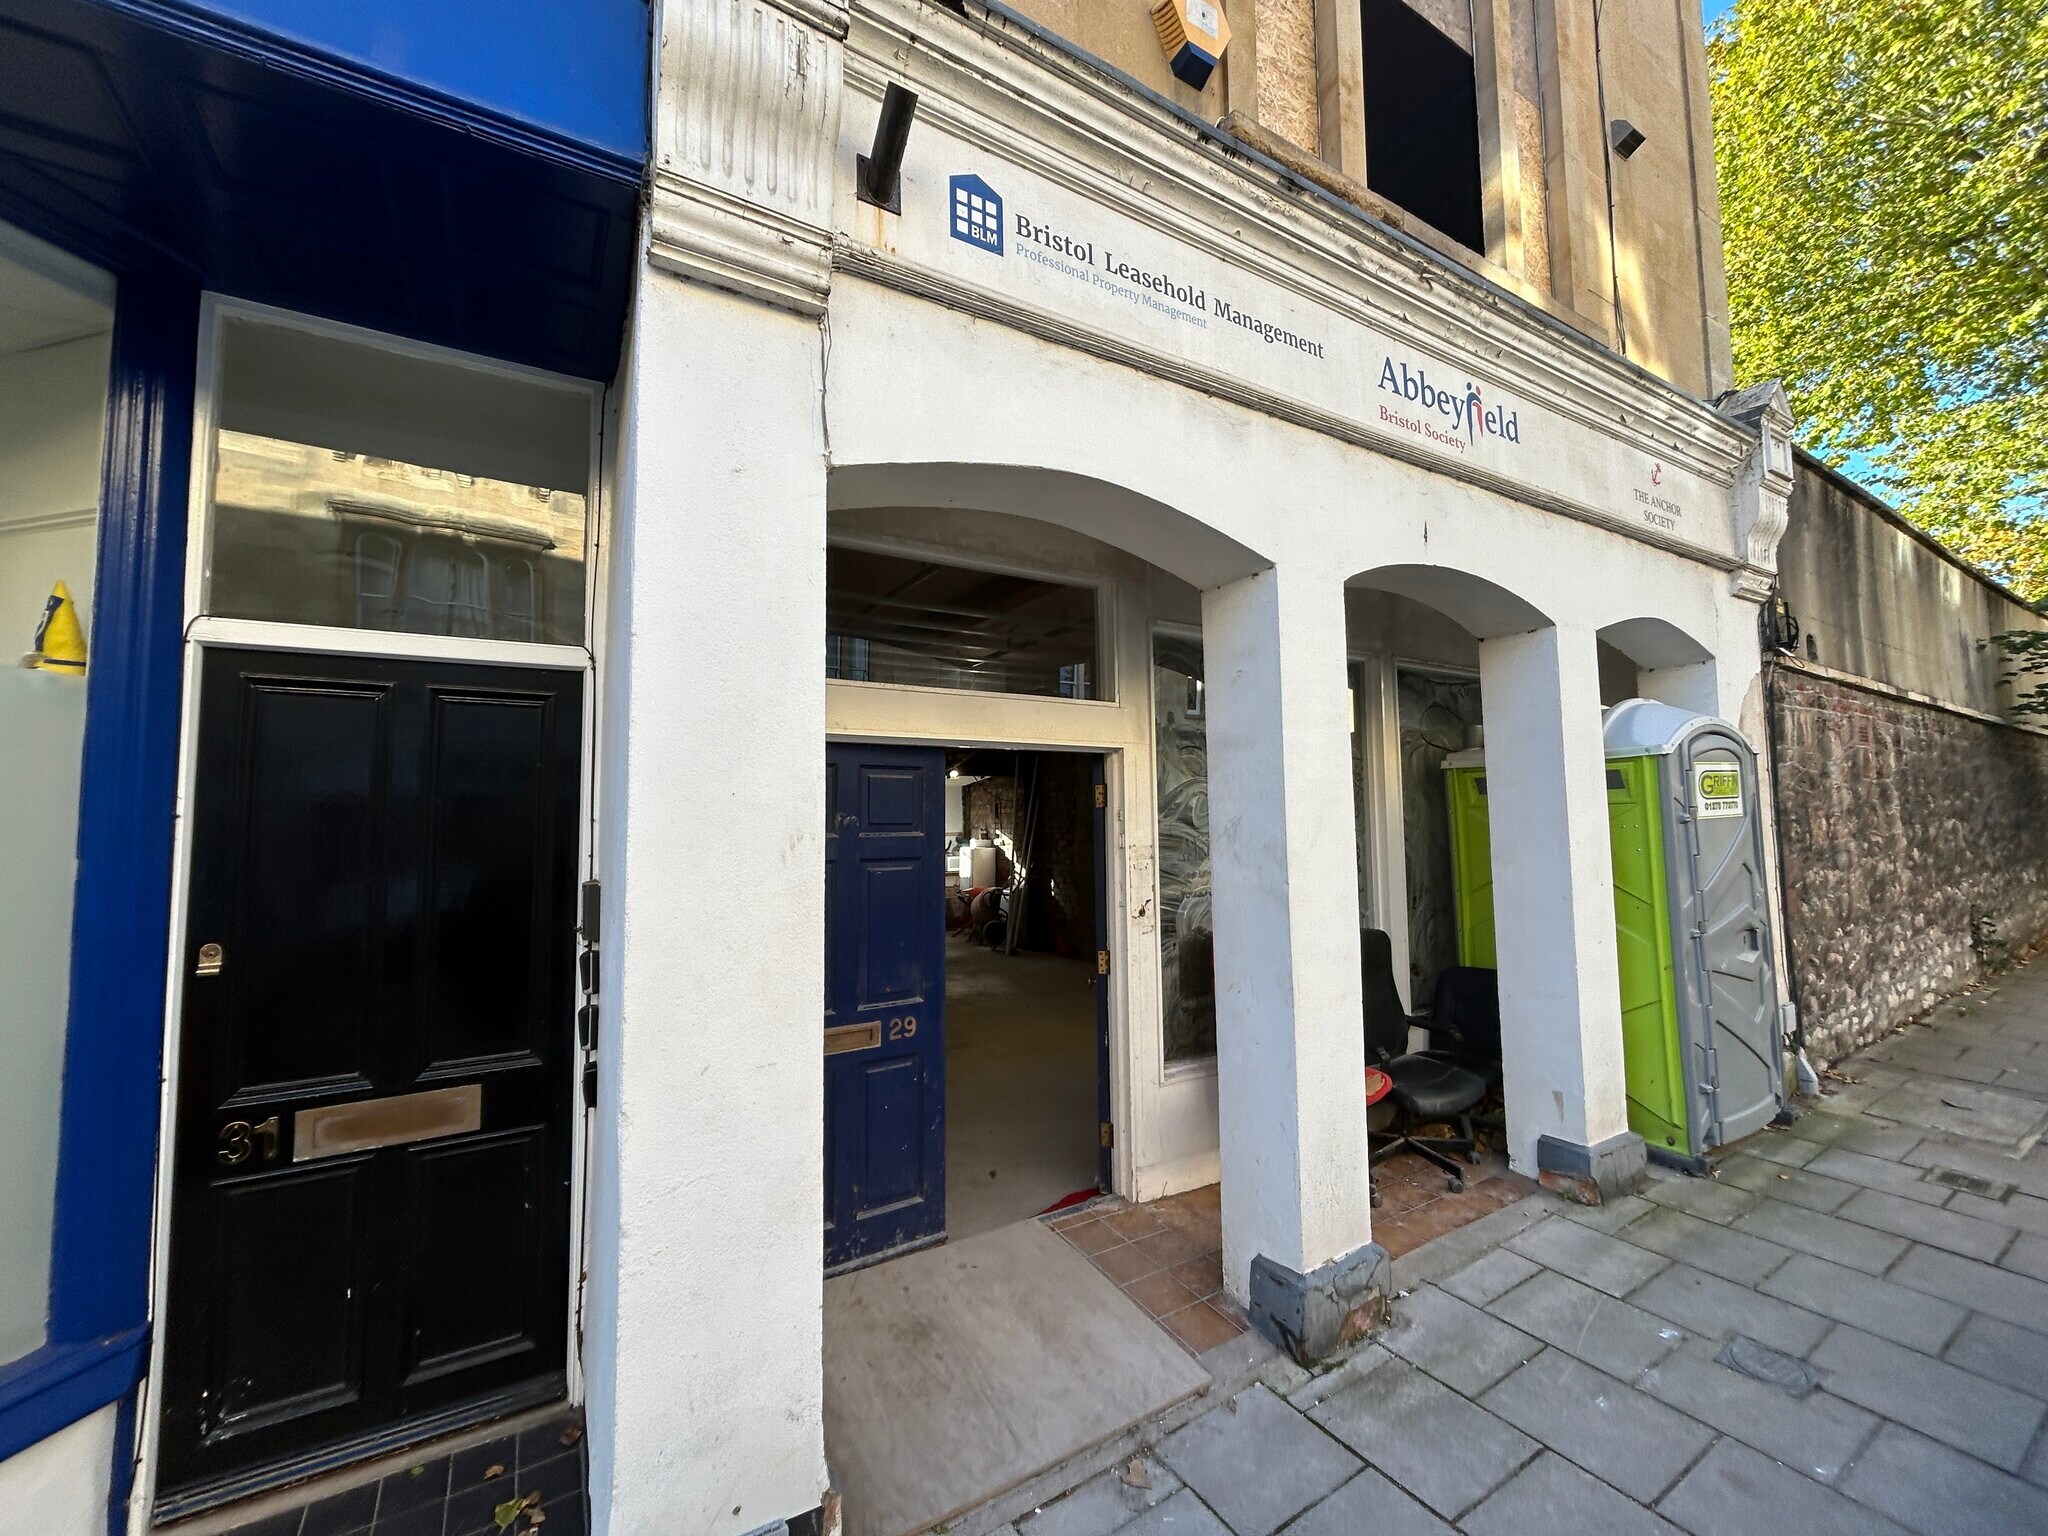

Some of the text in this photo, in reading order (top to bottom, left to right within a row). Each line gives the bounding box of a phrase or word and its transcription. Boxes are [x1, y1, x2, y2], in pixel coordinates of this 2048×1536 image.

[971, 224, 998, 246] BLM
[1015, 242, 1208, 329] Professional Property Management
[1015, 213, 1325, 360] Bristol Leasehold Management
[1378, 356, 1521, 446] Abbeyfield
[1379, 404, 1466, 453] Bristol Society
[1633, 488, 1682, 518] THE ANCHOR
[1643, 509, 1676, 531] SOCIETY
[889, 1015, 917, 1041] 29
[217, 1116, 279, 1166] 31
